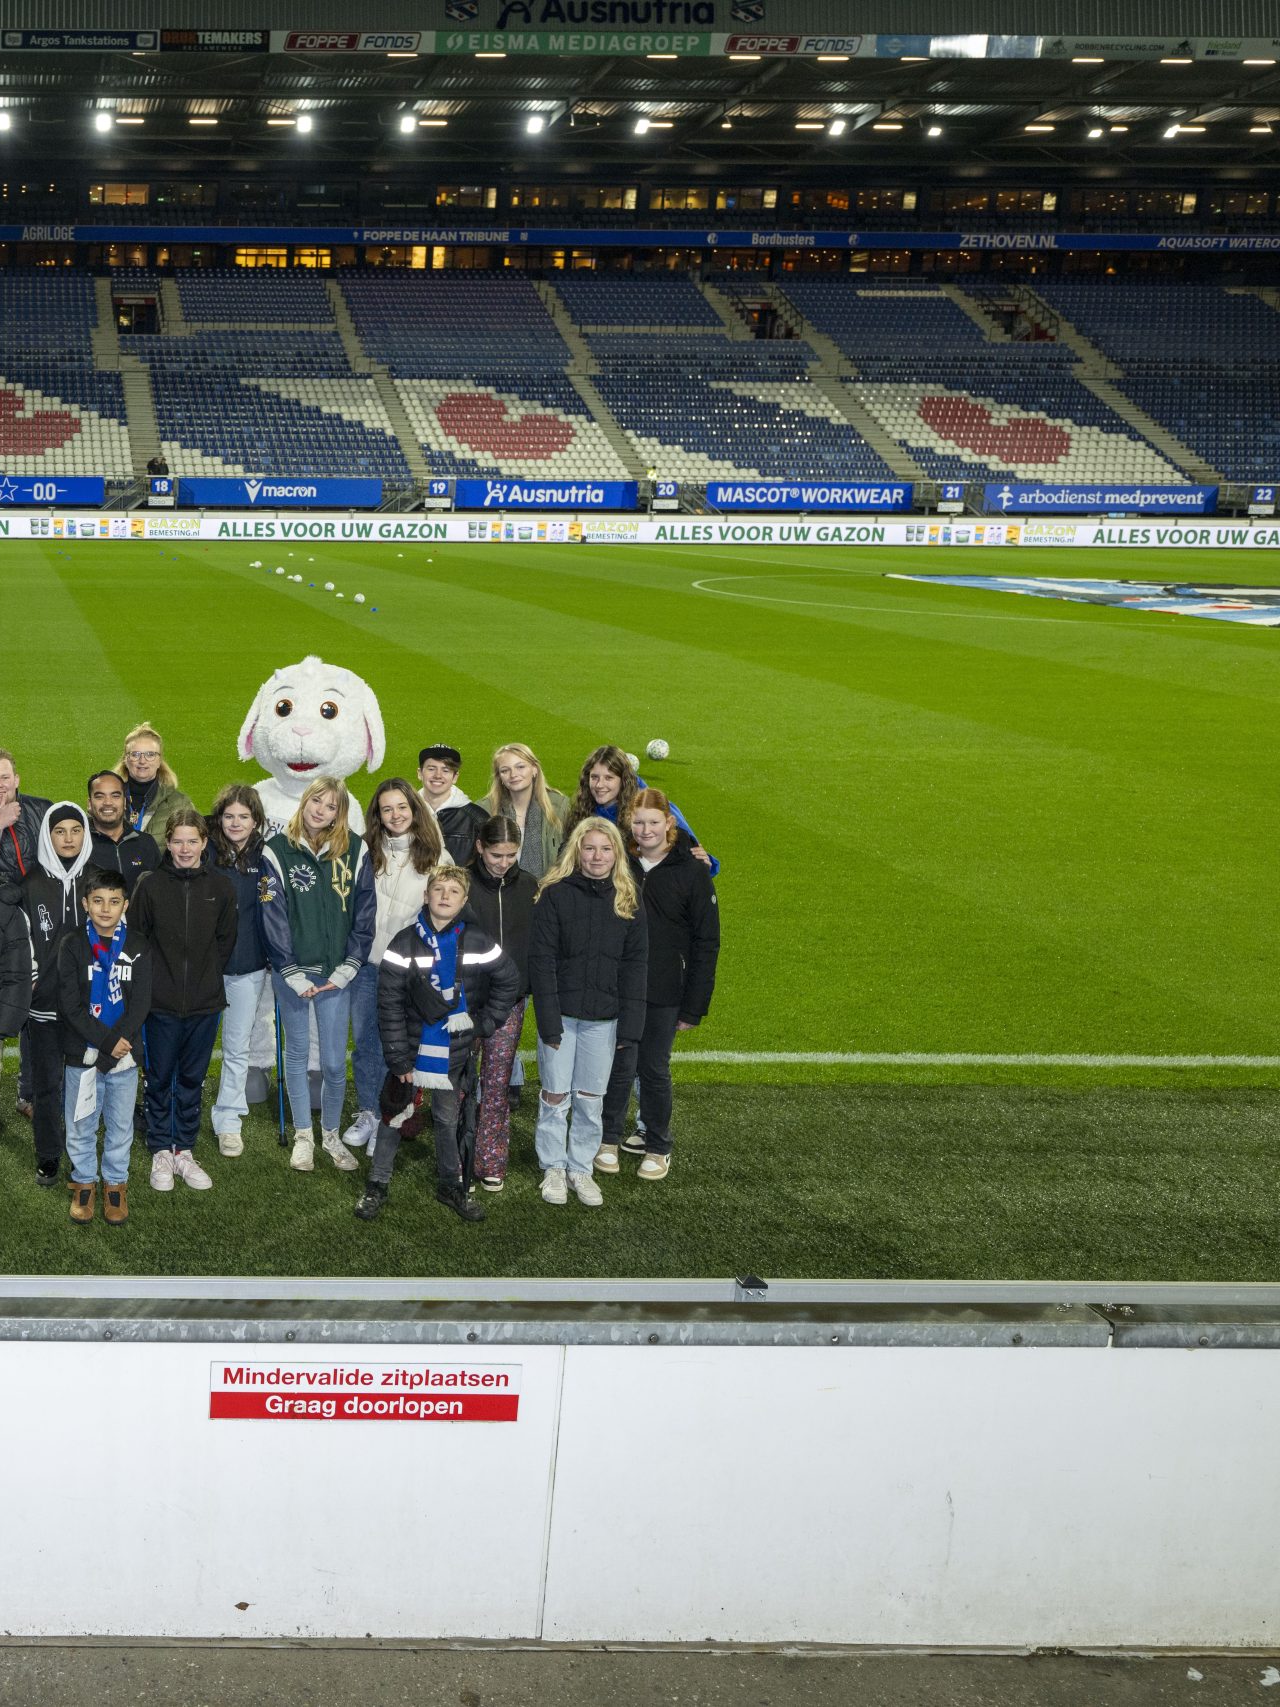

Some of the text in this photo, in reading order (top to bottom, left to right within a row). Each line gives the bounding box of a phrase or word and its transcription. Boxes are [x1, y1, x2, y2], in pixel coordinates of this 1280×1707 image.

[540, 0, 714, 24] Ausnutria
[30, 35, 60, 46] Argos
[64, 35, 129, 46] Tankstations
[296, 36, 414, 48] FOPPE FONDS
[468, 34, 699, 51] EISMA MEDIAGROEP
[736, 38, 853, 52] FOPPE FONDS
[22, 226, 75, 241] AGRILOGE
[363, 231, 510, 242] FOPPE DE HAAN TRIBUNE
[751, 233, 815, 246] Bordbusters
[959, 234, 1059, 248] ZETHOVEN.NL
[1157, 237, 1227, 249] AQUASOFT
[155, 480, 168, 492] 18
[263, 485, 317, 498] macron
[432, 482, 446, 494] 19
[658, 484, 674, 496] 20
[947, 486, 959, 498] 21
[508, 485, 604, 503] Ausnutria
[801, 488, 904, 504] WORKWEAR
[1019, 489, 1204, 507] arbodienst medprevent
[1256, 489, 1272, 500] 22
[148, 519, 201, 529] GAZON
[218, 522, 447, 539] ALLES VOOR UW GAZON
[585, 522, 639, 532] GAZON
[1023, 525, 1077, 536] GAZON
[149, 529, 200, 537] BEMESTING.nl
[586, 532, 637, 540] BEMESTING.nl
[655, 525, 885, 542] ALLES VOOR UW GAZON
[1092, 528, 1151, 544] ALLES
[1156, 529, 1211, 544] VOOR
[1216, 529, 1249, 544] UW
[223, 1367, 509, 1390] Mindervalide zitplaatsen
[265, 1395, 463, 1418] Graag doorlopen
